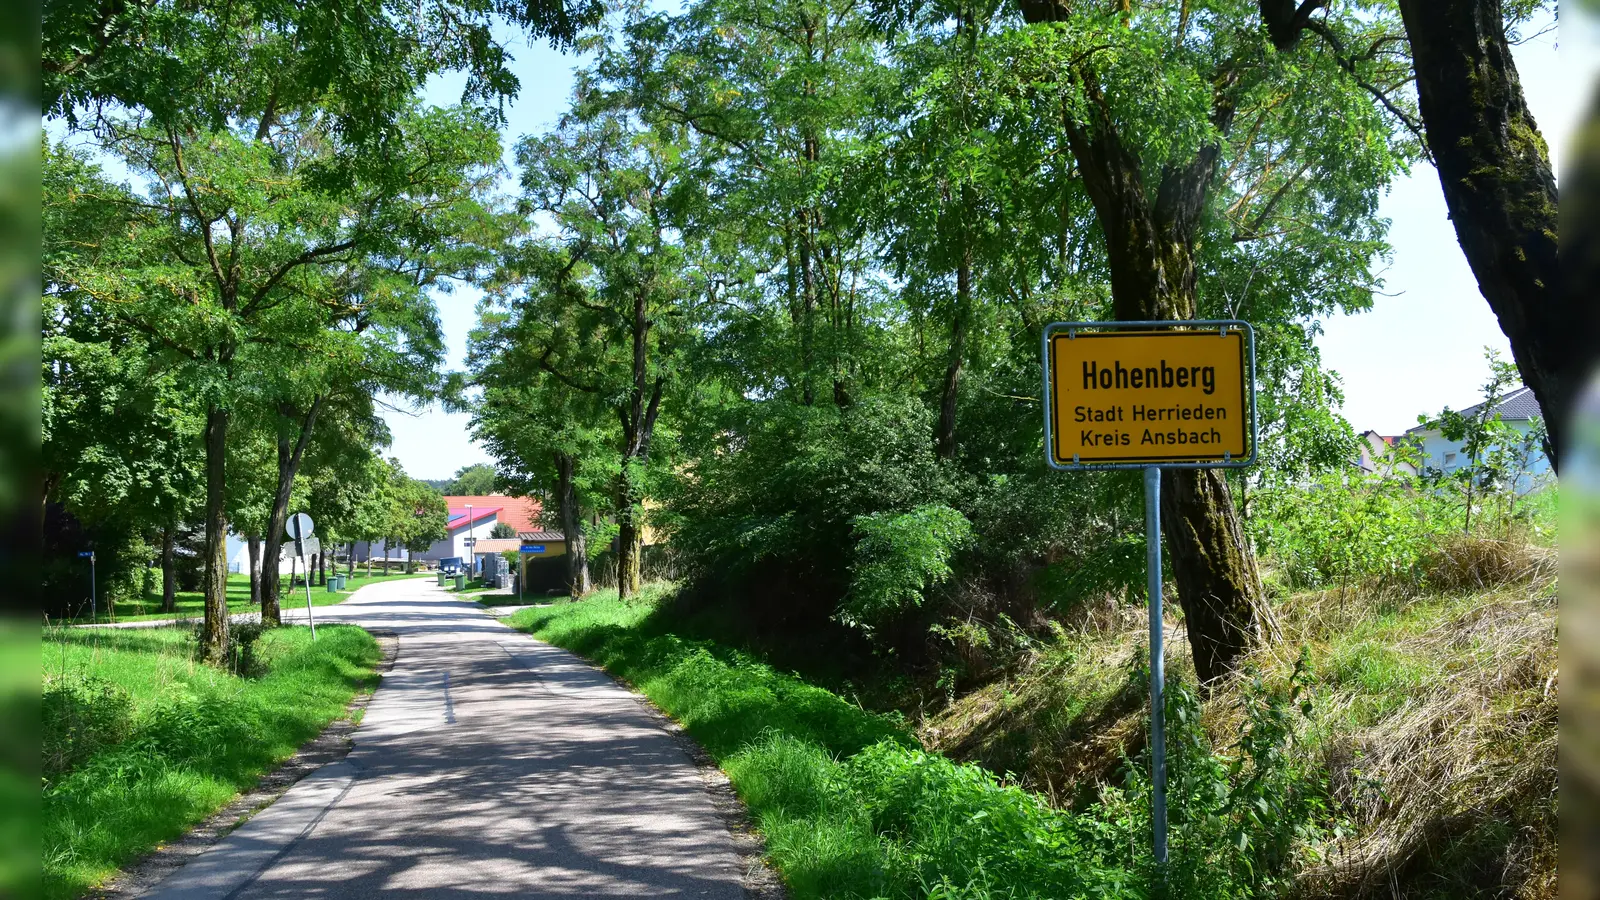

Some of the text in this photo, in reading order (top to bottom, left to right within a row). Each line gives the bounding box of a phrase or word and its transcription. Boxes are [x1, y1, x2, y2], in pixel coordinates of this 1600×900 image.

[1083, 360, 1215, 395] Hohenberg
[1074, 404, 1227, 423] Stadt Herrieden
[1081, 427, 1221, 447] Kreis Ansbach
